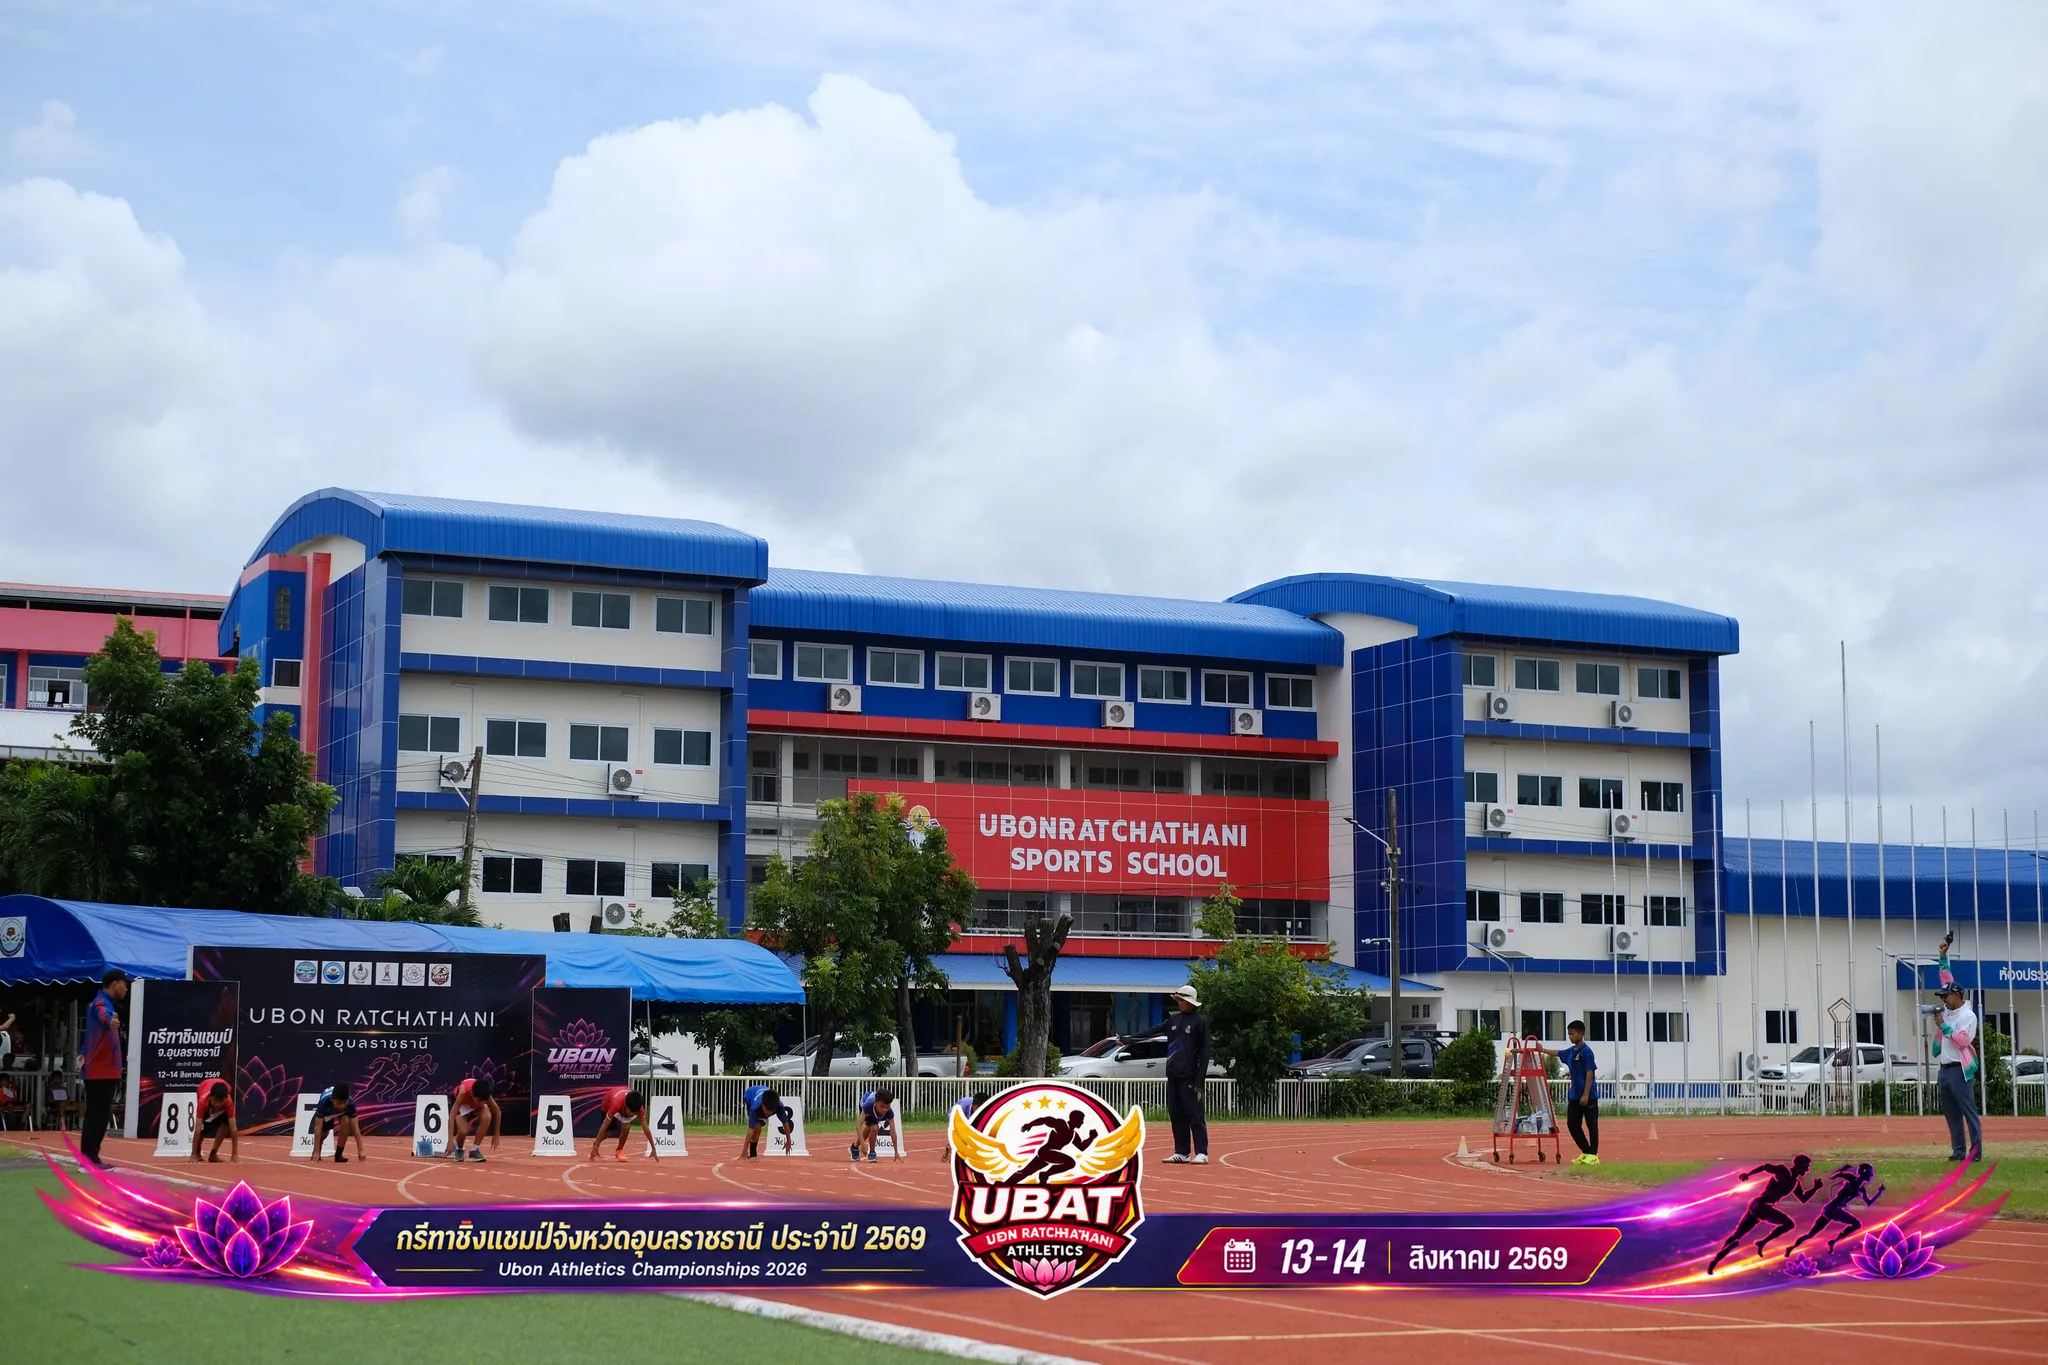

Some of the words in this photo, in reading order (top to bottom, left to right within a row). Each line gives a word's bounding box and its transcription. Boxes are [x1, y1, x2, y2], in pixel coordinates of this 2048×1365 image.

[979, 813, 1247, 847] UBONRATCHATHANI
[1011, 847, 1113, 873] SPORTS
[1127, 851, 1227, 878] SCHOOL
[249, 1008, 325, 1025] UBON
[337, 1009, 495, 1027] RATCHATHANI
[547, 1048, 617, 1063] UBON
[548, 1063, 613, 1072] ATHLETICS
[167, 1103, 179, 1134] 8
[188, 1101, 195, 1132] 8
[424, 1103, 441, 1133] 6
[545, 1105, 564, 1134] 5
[657, 1106, 675, 1135] 4
